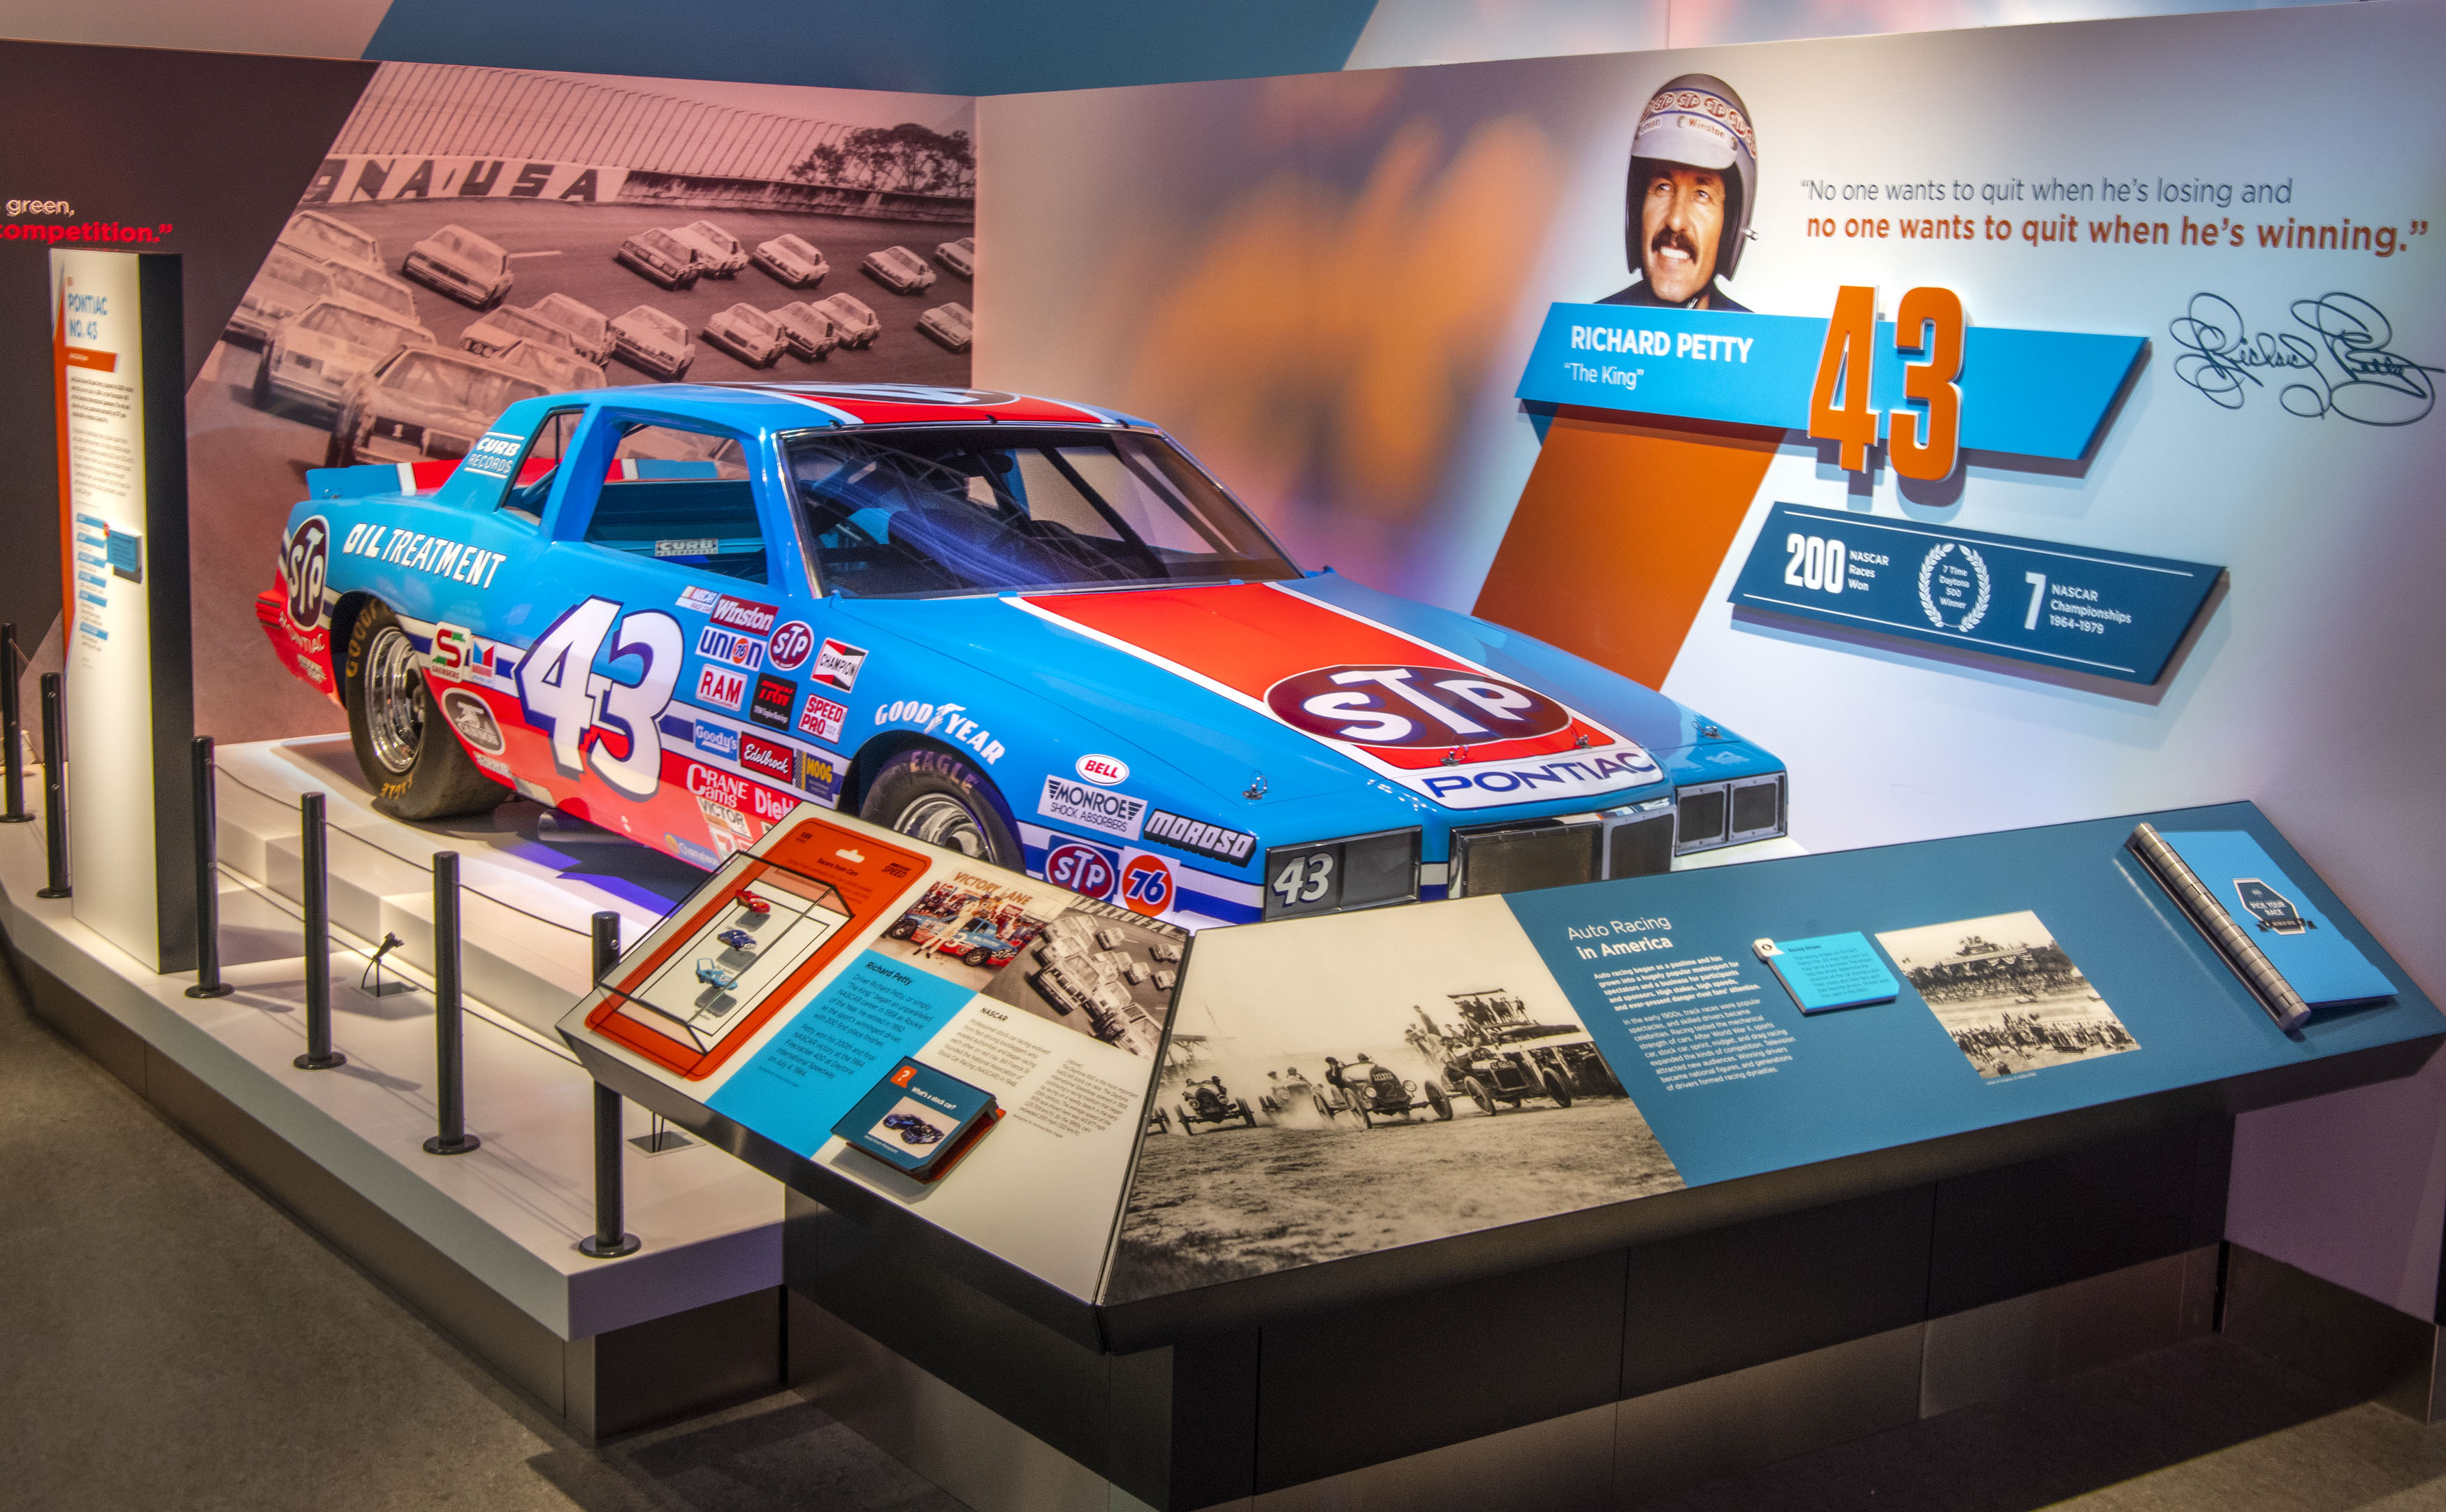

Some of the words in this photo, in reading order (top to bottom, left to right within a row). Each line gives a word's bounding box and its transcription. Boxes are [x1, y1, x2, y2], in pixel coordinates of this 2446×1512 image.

[1689, 118, 1725, 138] Winston
[1801, 180, 1837, 201] “No
[1842, 183, 1879, 201] one
[1886, 180, 1946, 201] wants
[1953, 180, 1974, 201] to
[1981, 177, 2025, 205] quit
[2032, 177, 2094, 202] when
[2101, 177, 2148, 203] he’s
[2157, 177, 2233, 208] losing
[2241, 177, 2293, 204] and
[6, 199, 75, 217] green,
[0, 221, 173, 245] ompetition.”
[1807, 217, 1837, 238] no
[1844, 217, 1890, 239] one
[1899, 215, 1976, 240] wants
[1985, 214, 2013, 240] to
[2022, 214, 2079, 247] quit
[2088, 215, 2169, 245] when
[2181, 215, 2245, 247] he’s
[68, 293, 108, 315] PONTIAC
[87, 321, 98, 340] 43
[1570, 325, 1671, 358] RICHARD
[1677, 332, 1753, 363] PETTY
[1564, 362, 1598, 384] “The
[1601, 365, 1644, 391] King”
[1807, 285, 1964, 481] 43
[476, 437, 521, 457] CURB
[468, 453, 514, 474] RECORDS
[342, 523, 388, 559] OIL
[381, 528, 507, 590] TREATMENT
[1784, 532, 1846, 594] 200
[1849, 549, 1890, 567] NASCAR
[1848, 564, 1876, 579] Races
[1939, 574, 1970, 588] Daytona
[1949, 565, 1968, 577] Time
[1847, 578, 1869, 592] Won
[1945, 587, 1962, 598] 500
[2051, 583, 2099, 602] NASCAR
[1939, 597, 1967, 609] Winner
[2024, 571, 2047, 630] 7
[2050, 599, 2132, 625] Championships
[713, 599, 774, 631] Winston
[773, 625, 809, 662] STP
[819, 653, 857, 677] CHAMPION
[514, 595, 684, 803] 43
[700, 671, 743, 705] RAM
[758, 680, 794, 707] TRW
[806, 697, 844, 723] SPEED
[1302, 668, 1535, 742] STP
[802, 713, 826, 735] PRO
[744, 743, 789, 774] Edelbrock
[806, 757, 833, 783] MOOG
[1084, 759, 1119, 780] BELL
[687, 763, 749, 800] CRANE
[910, 750, 978, 795] EAGLE
[1422, 753, 1657, 799] PONTIAC
[699, 797, 744, 826] VICTOR
[1055, 785, 1128, 820] MONROE
[1050, 801, 1078, 820] SHOCK
[1079, 808, 1127, 833] ABSORBERS
[1145, 809, 1256, 858] MOROSO
[882, 865, 907, 878] SPEED
[1054, 850, 1107, 891] STP
[1271, 852, 1334, 908] 43
[953, 872, 1002, 893] VICTORY
[1001, 888, 1033, 906] LANE
[1126, 868, 1168, 906] 76
[2264, 908, 2285, 917] RACE
[2266, 899, 2287, 908] YOUR
[1568, 925, 1609, 941] Auto
[1611, 917, 1672, 934] Racing
[1577, 944, 1598, 960] in
[1601, 936, 1673, 957] America
[865, 961, 894, 979] Richard
[892, 972, 914, 987] Petty
[1598, 980, 1621, 988] grown
[1692, 963, 1729, 973] motorsport
[1670, 959, 1696, 968] pastime
[1603, 985, 1640, 995] spectators
[1700, 970, 1739, 980] participants
[1623, 991, 1656, 1001] sponsors.
[1628, 997, 1672, 1008] ever-present
[1729, 984, 1761, 993] attention.
[980, 1007, 1009, 1024] NASCAR
